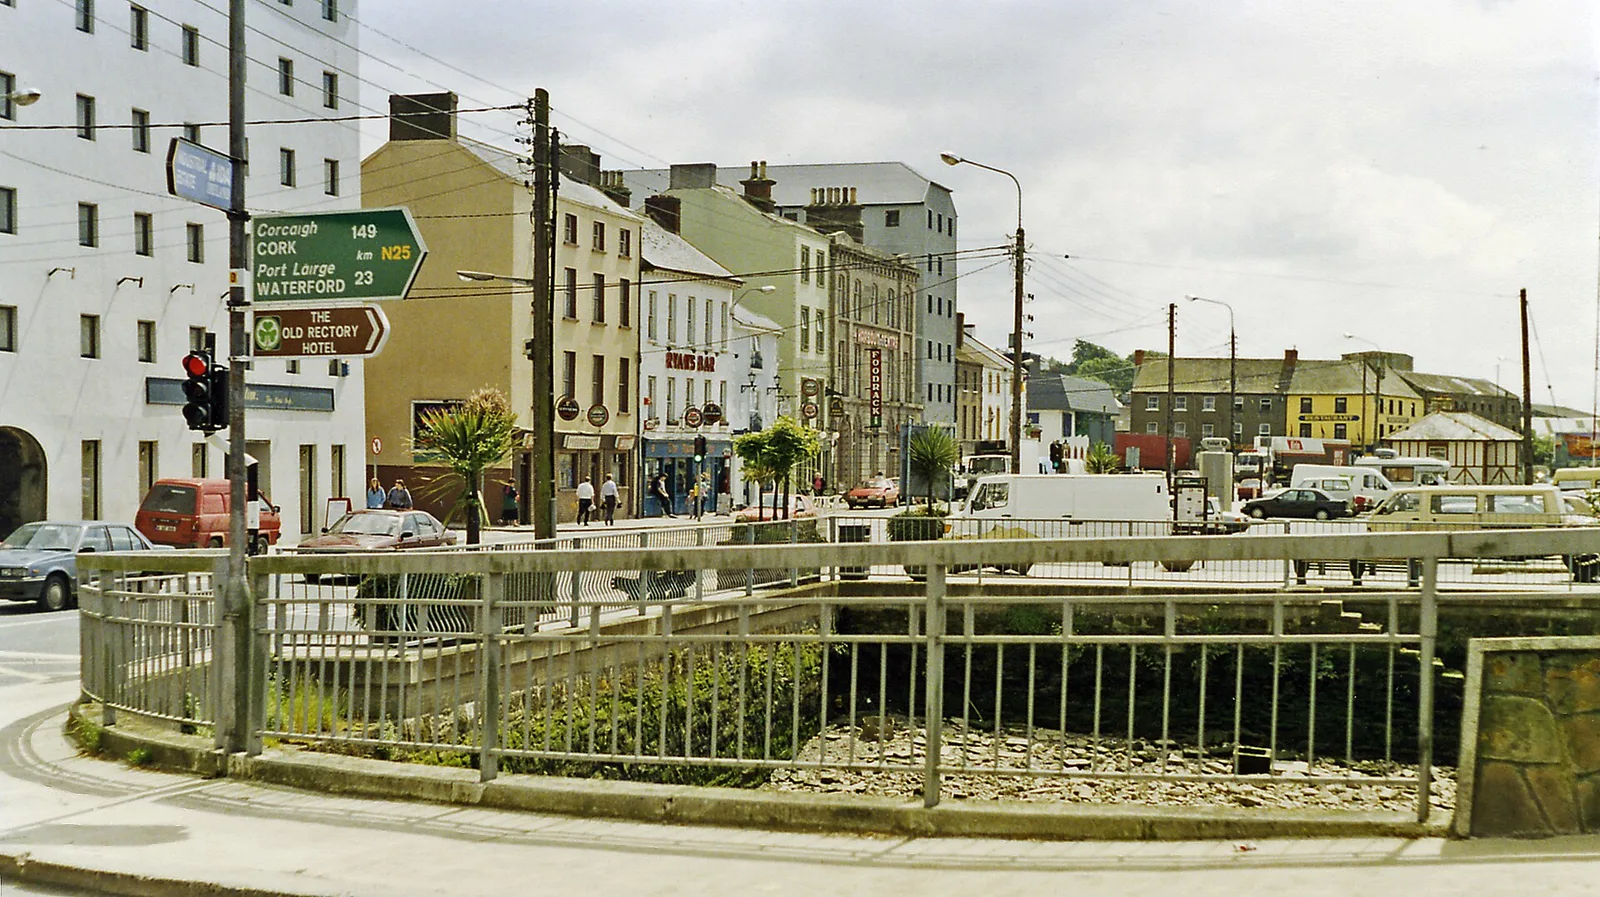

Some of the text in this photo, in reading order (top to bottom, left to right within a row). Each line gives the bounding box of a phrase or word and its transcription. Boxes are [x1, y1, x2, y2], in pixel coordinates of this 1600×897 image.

[257, 221, 318, 237] Corcaigh
[351, 223, 377, 239] 149
[257, 240, 297, 256] CORK
[356, 245, 411, 260] km N25
[257, 263, 287, 277] Port
[354, 270, 374, 286] 23
[257, 279, 346, 296] WATERFORD
[311, 311, 331, 323] THE
[282, 325, 359, 339] OLD RECTORY
[302, 341, 337, 354] HOTEL
[665, 352, 716, 373] RYAN'S BAR
[871, 350, 881, 415] FOODRACK
